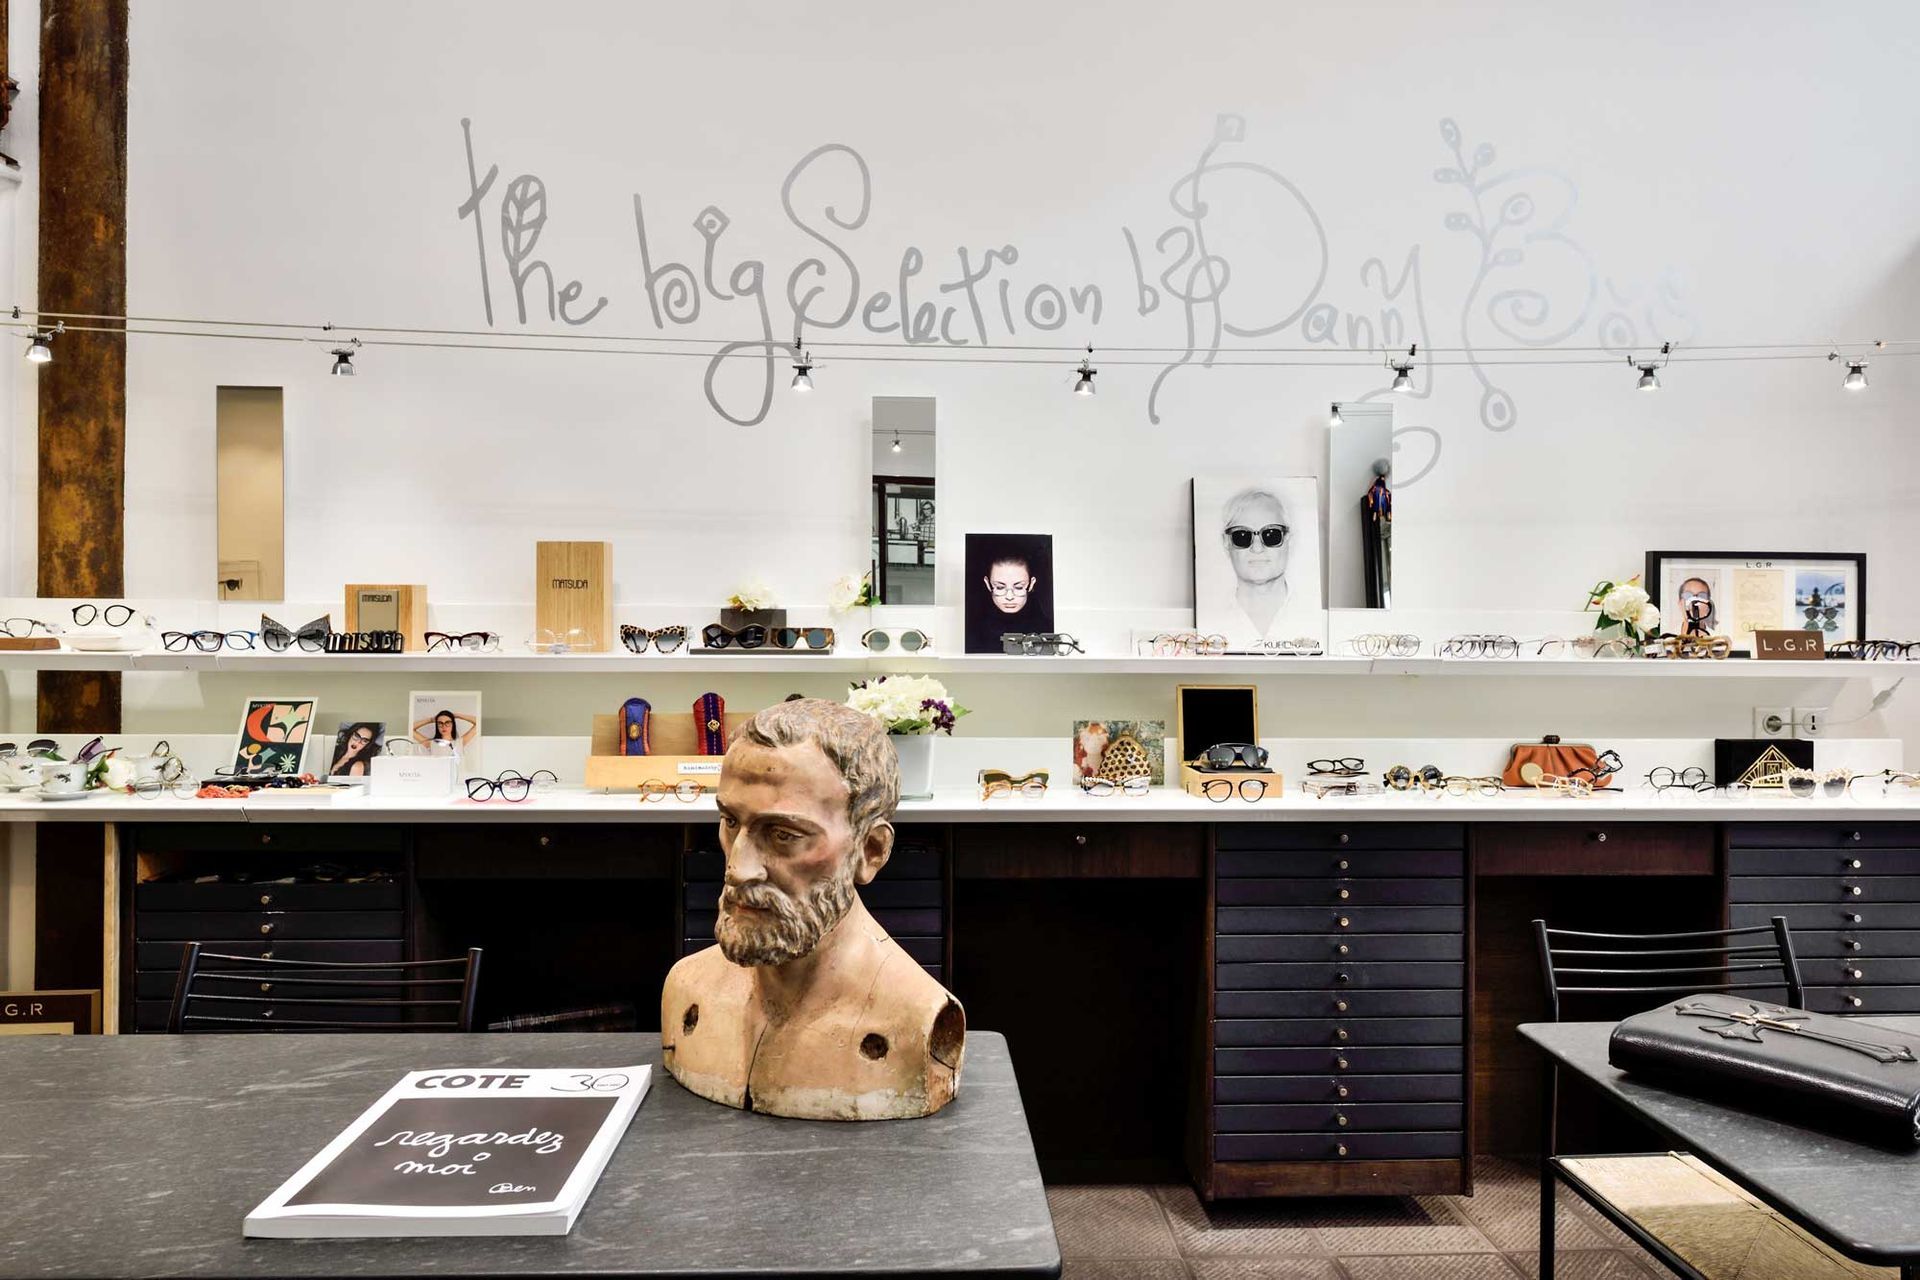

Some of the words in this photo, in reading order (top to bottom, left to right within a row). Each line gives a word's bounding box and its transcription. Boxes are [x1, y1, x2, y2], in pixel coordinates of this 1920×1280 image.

[458, 117, 608, 326] the
[632, 193, 774, 427] big
[1170, 113, 1441, 488] Danny
[552, 579, 588, 589] MATSUDA
[1761, 638, 1818, 651] L.G.R
[414, 1074, 530, 1090] COTE
[550, 1074, 629, 1092] 30
[374, 1127, 564, 1158] regardez
[394, 1152, 491, 1175] moi
